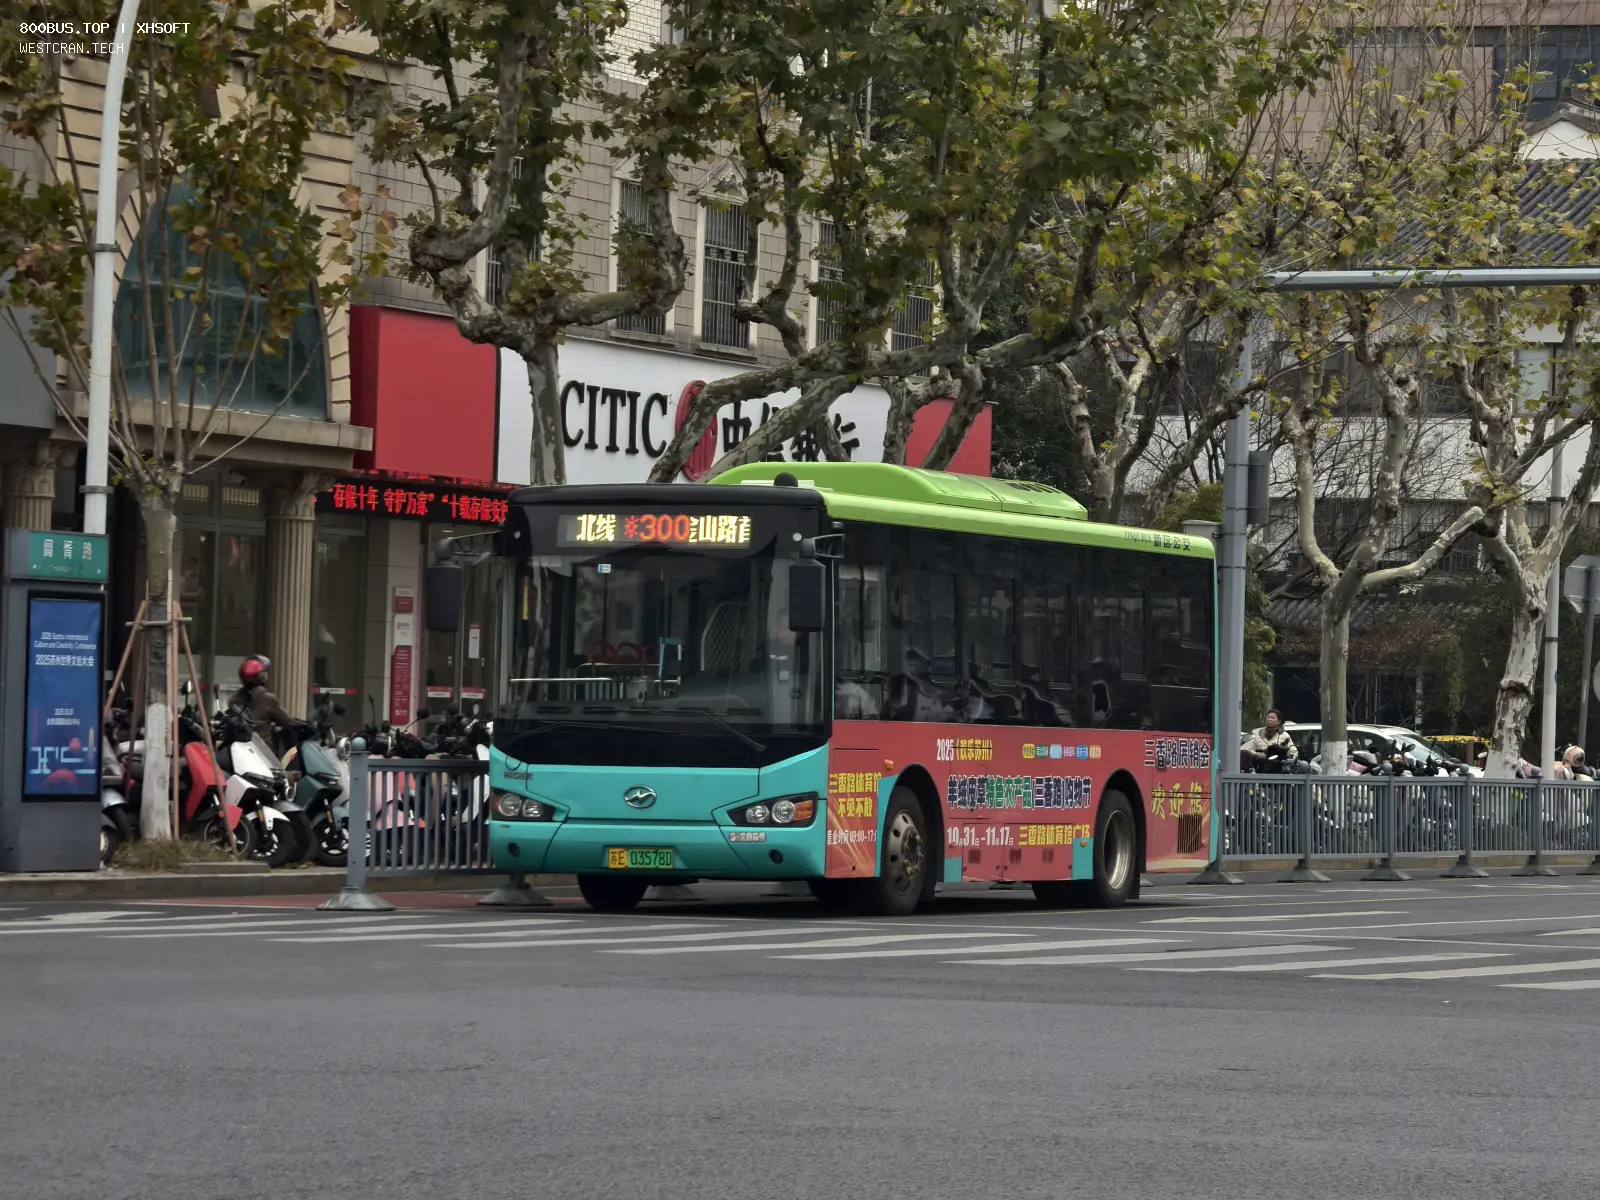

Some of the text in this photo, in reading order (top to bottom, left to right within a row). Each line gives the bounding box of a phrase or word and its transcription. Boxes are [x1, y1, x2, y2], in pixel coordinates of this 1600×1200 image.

[560, 380, 668, 457] CITIC
[576, 514, 617, 542] 北线
[639, 514, 691, 542] 300
[1153, 533, 1191, 551] 新区公交
[1144, 737, 1210, 769] 三香路展销会
[503, 771, 534, 780] HIGER
[837, 796, 873, 818] 不见不散
[1151, 781, 1203, 820] 欢迎您
[630, 850, 672, 866] 03578D
